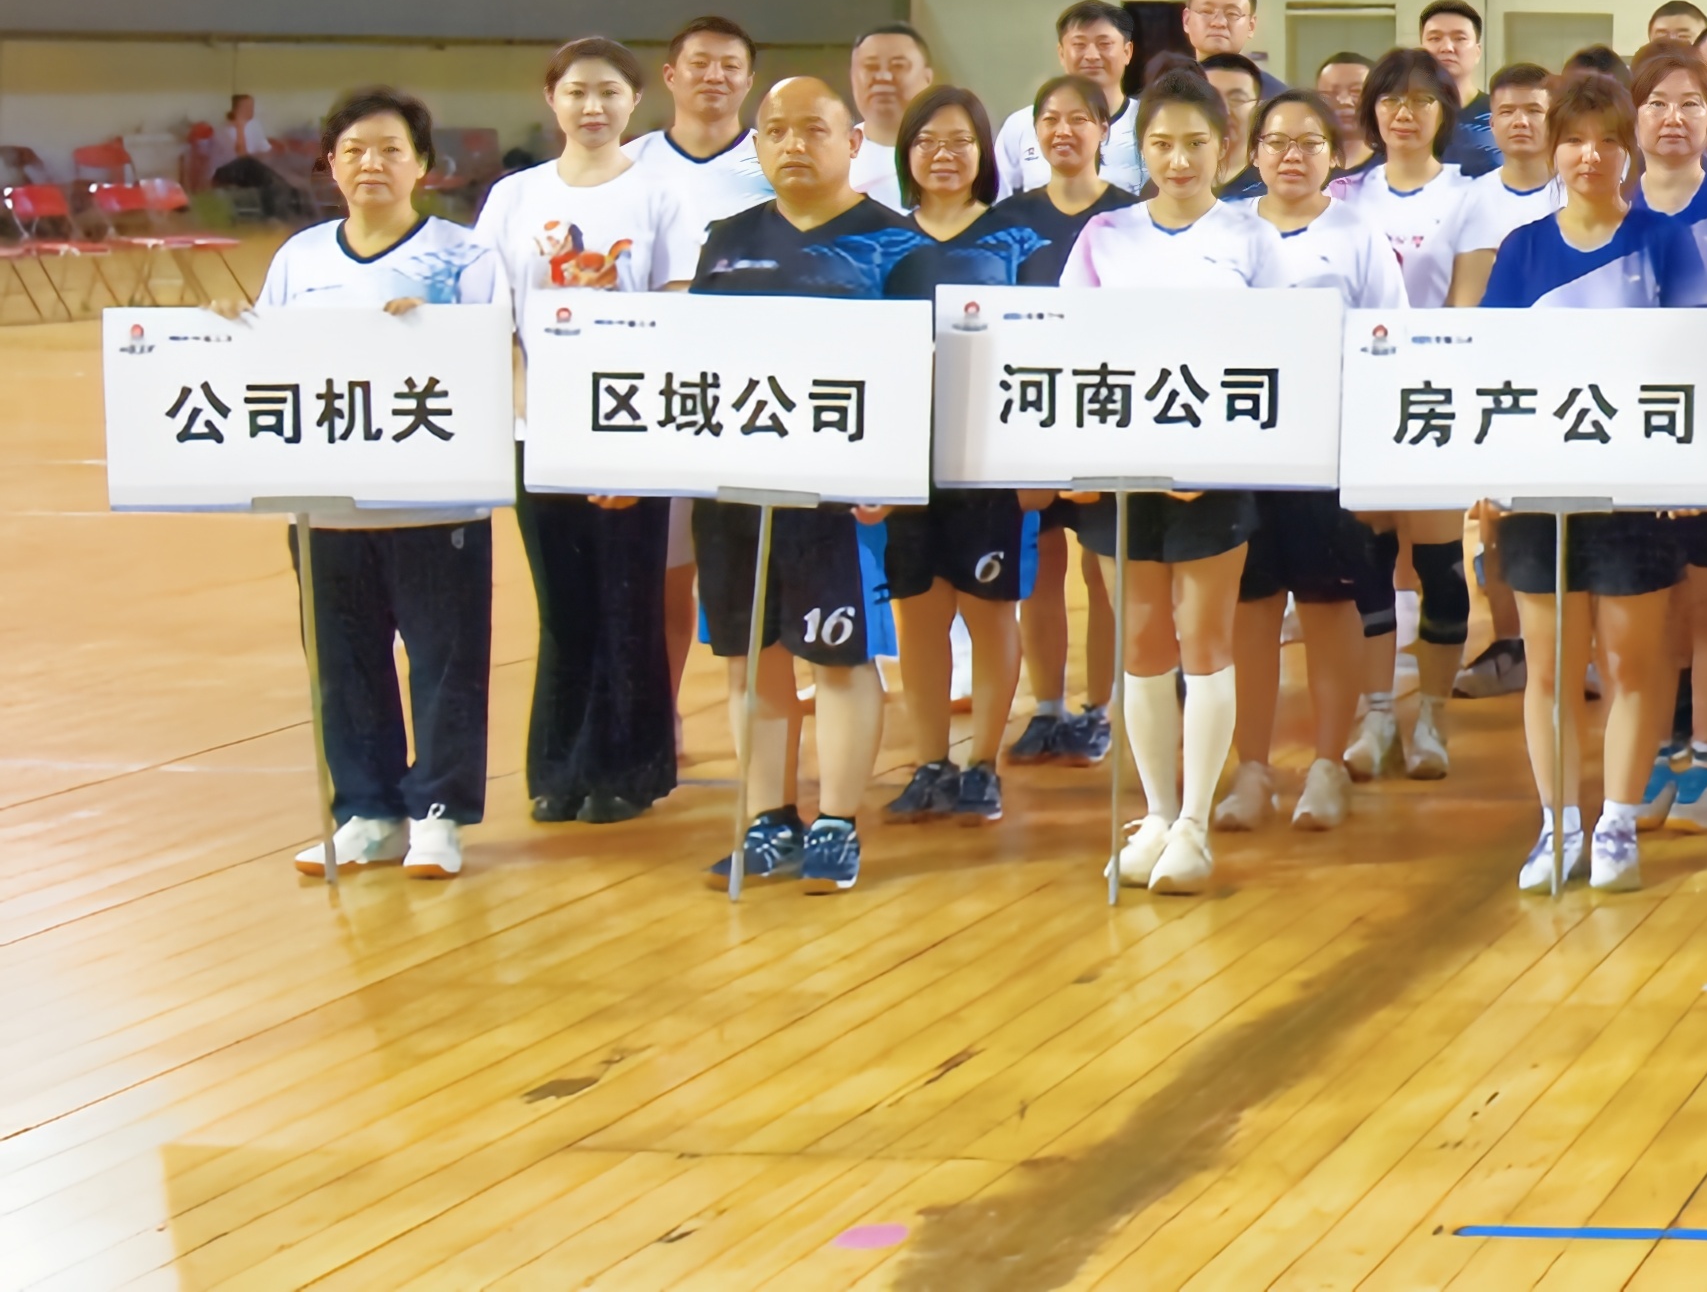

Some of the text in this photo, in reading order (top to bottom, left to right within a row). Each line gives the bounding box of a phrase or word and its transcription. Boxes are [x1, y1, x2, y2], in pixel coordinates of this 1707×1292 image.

[165, 377, 455, 444] 公司机关
[590, 371, 866, 442] 区域公司
[999, 362, 1280, 430] 河南公司
[1393, 380, 1695, 448] 房产公司
[975, 550, 1004, 583] 6
[803, 606, 856, 646] 16
